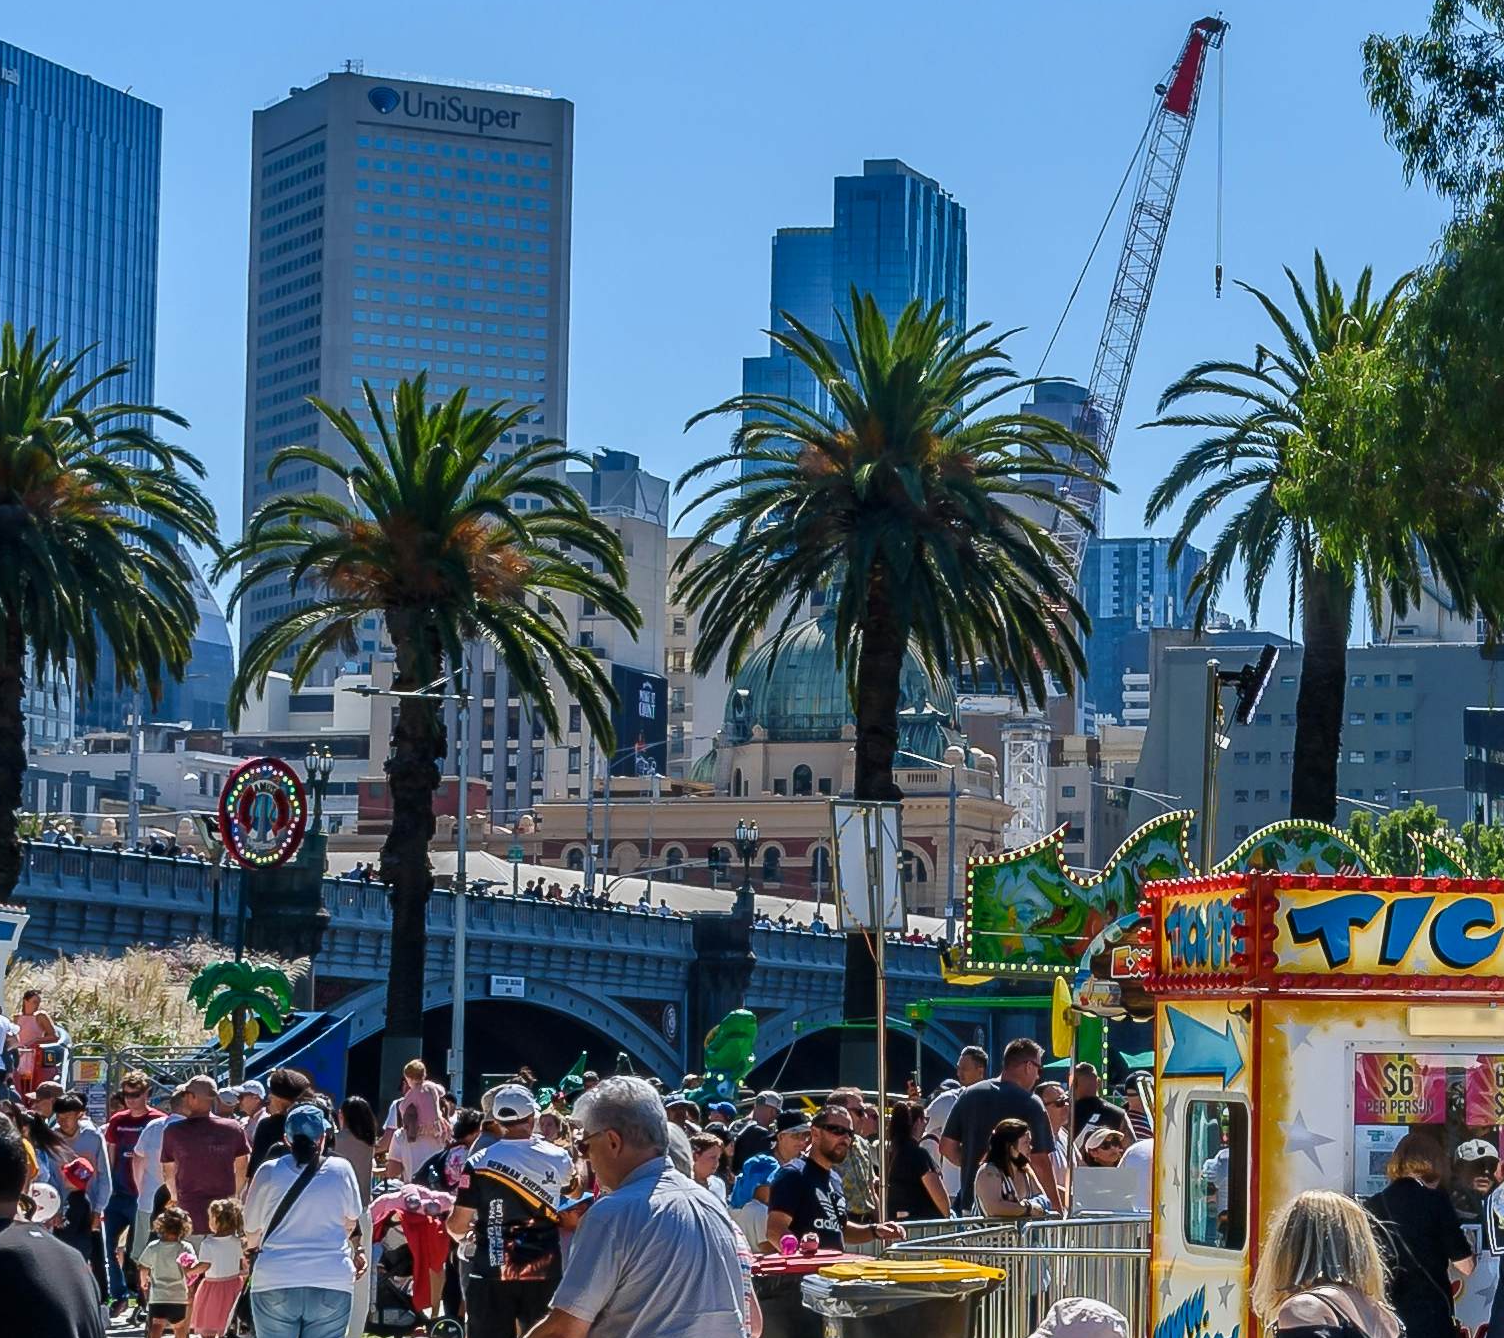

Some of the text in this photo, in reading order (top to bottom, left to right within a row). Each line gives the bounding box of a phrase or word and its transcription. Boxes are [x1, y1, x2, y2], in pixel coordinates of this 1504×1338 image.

[403, 90, 521, 133] UniSuper
[1383, 1062, 1414, 1098] $6
[1365, 1101, 1434, 1116] PER PERSON
